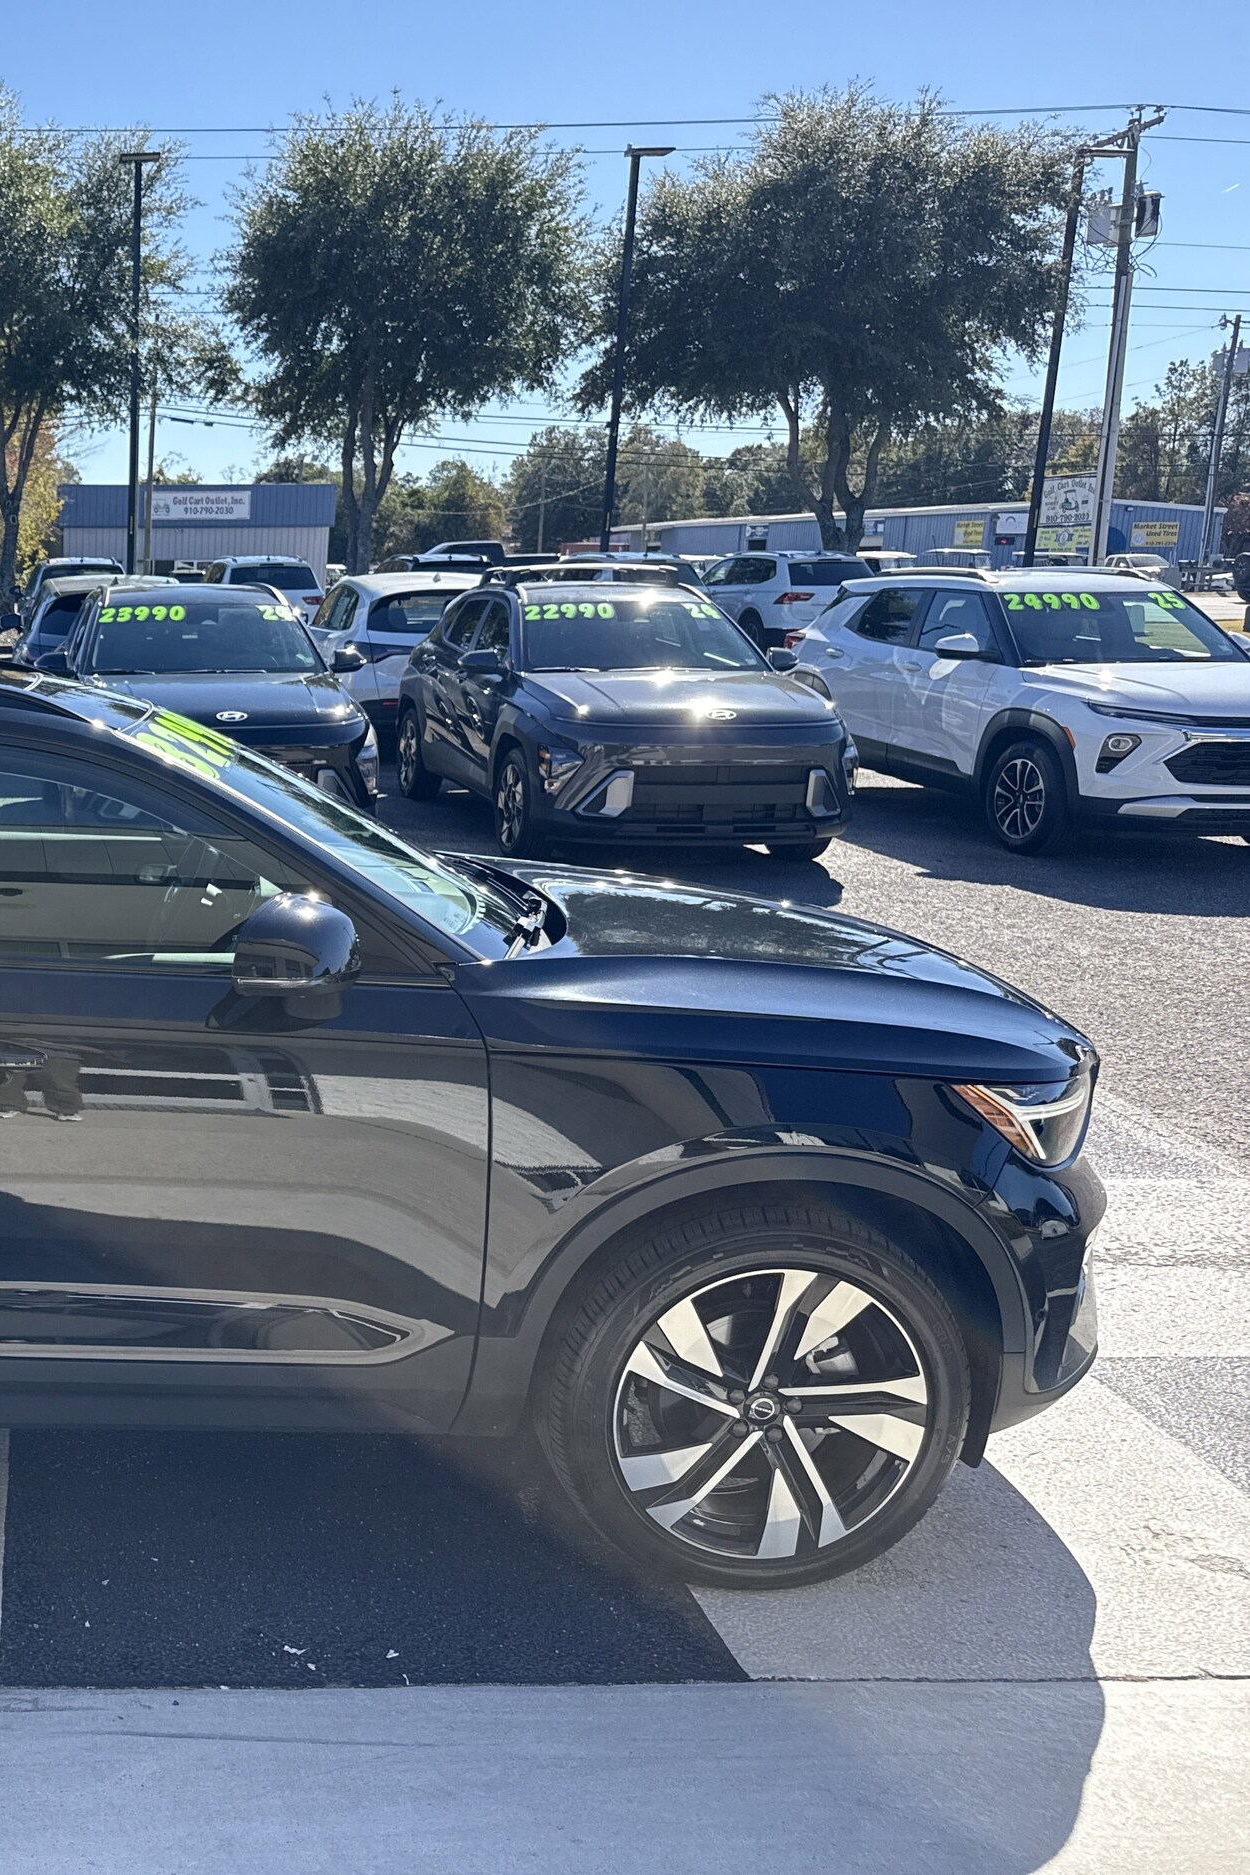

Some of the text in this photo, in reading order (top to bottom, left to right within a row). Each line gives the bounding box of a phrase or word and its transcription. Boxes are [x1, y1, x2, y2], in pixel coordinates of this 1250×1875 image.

[173, 496, 188, 505] Golf
[189, 496, 204, 505] Cart
[184, 506, 234, 515] 910-790-2030
[1003, 592, 1186, 611] 24990 25
[98, 605, 186, 623] 23990
[524, 602, 615, 621] 22990
